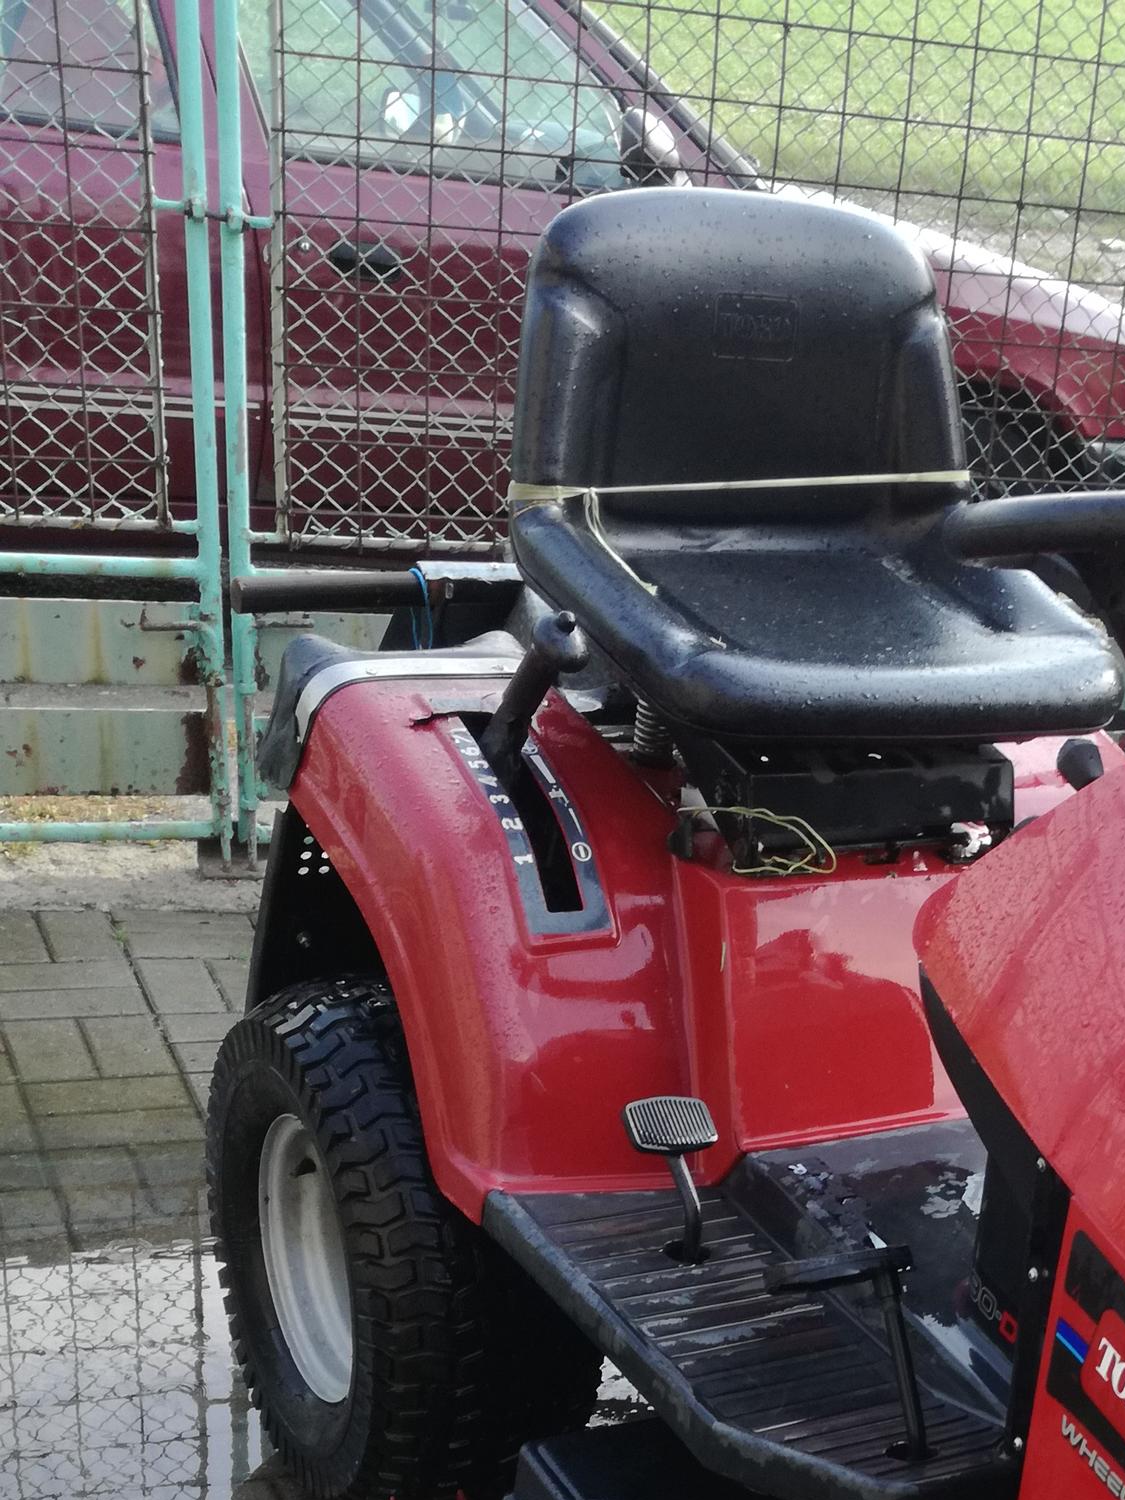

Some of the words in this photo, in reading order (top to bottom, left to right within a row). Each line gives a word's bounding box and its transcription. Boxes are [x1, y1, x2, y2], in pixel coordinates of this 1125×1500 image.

[460, 746, 481, 757] 6
[468, 759, 489, 771] 5
[477, 775, 498, 788] 4
[489, 794, 510, 805] 3
[501, 816, 524, 832] 2
[513, 853, 534, 866] 1
